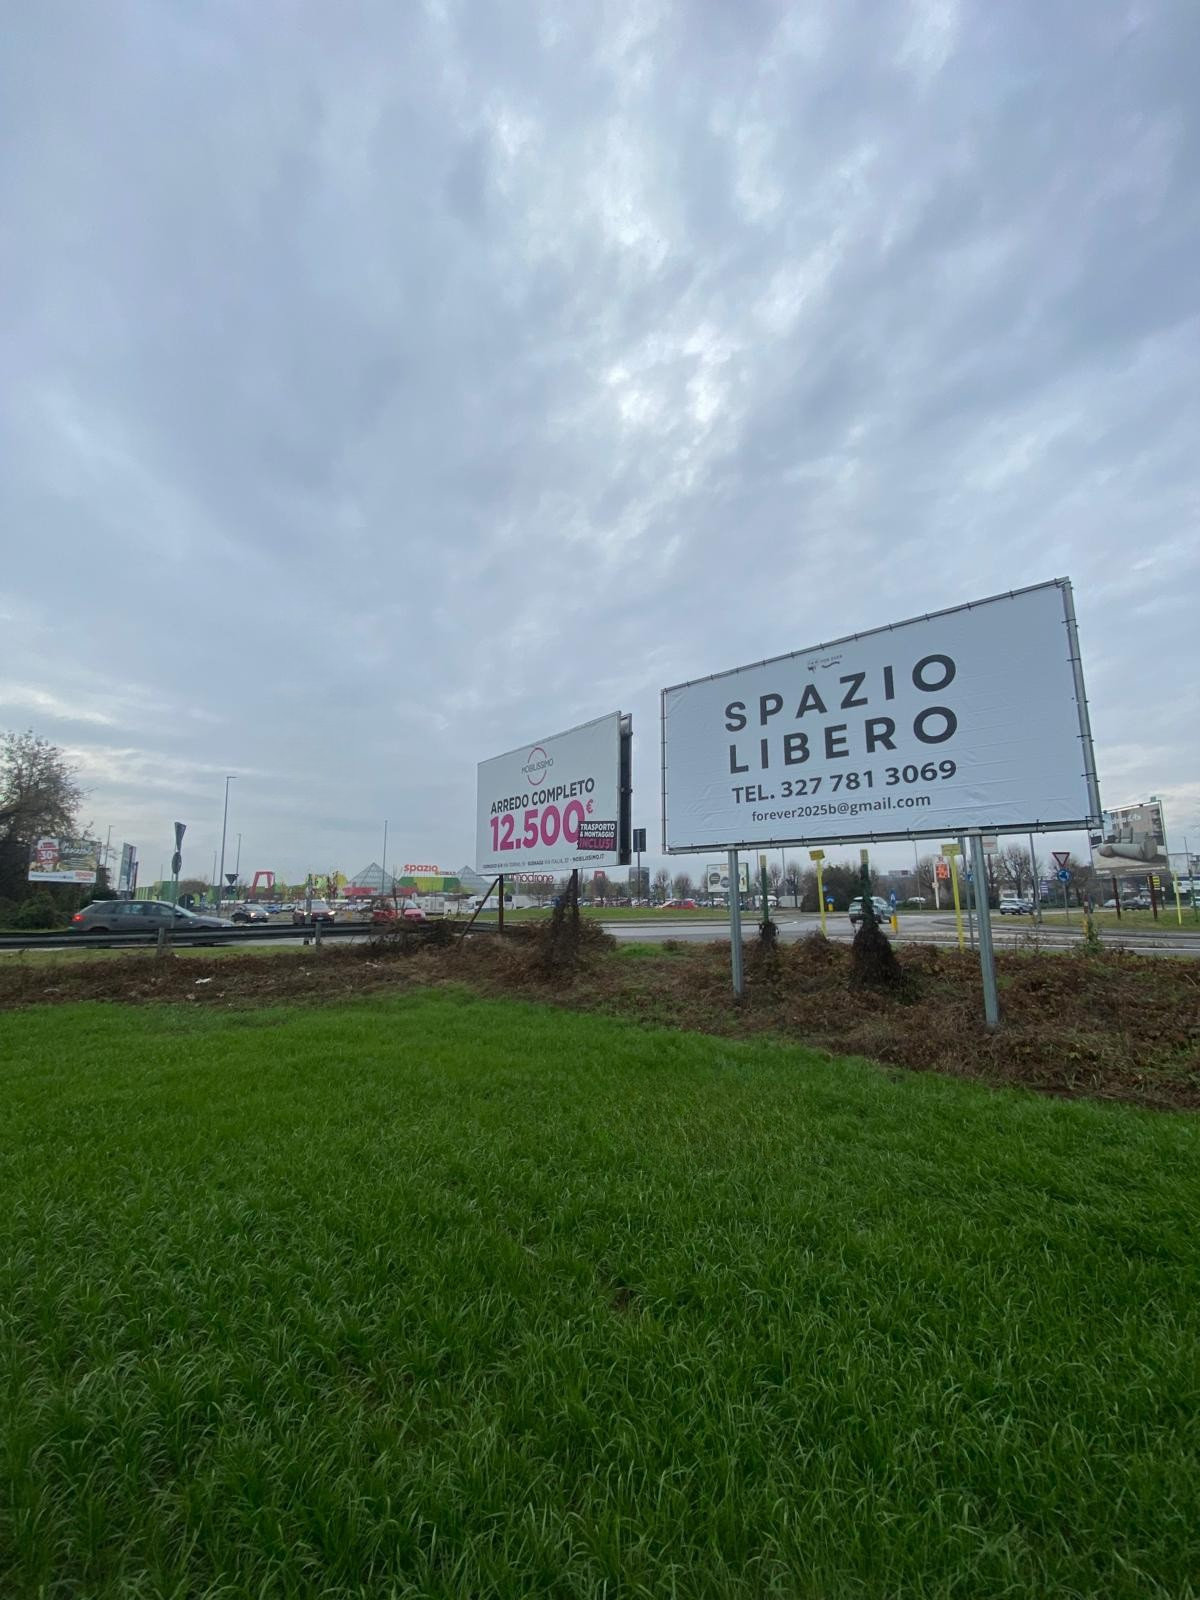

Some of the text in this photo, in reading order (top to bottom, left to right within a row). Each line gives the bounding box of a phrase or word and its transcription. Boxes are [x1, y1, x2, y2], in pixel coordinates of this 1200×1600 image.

[724, 654, 957, 732] SPAZIO
[729, 706, 958, 774] LIBERO
[521, 758, 554, 776] MOBILISSIMO
[732, 759, 957, 804] TEL. 327 781 3069
[490, 777, 595, 814] ARREDO COMPLETO
[751, 793, 931, 822] forever2025b@gmail.com
[580, 823, 615, 831] TRASPORTO
[579, 838, 614, 849] INCLUSI
[403, 864, 438, 874] spazio
